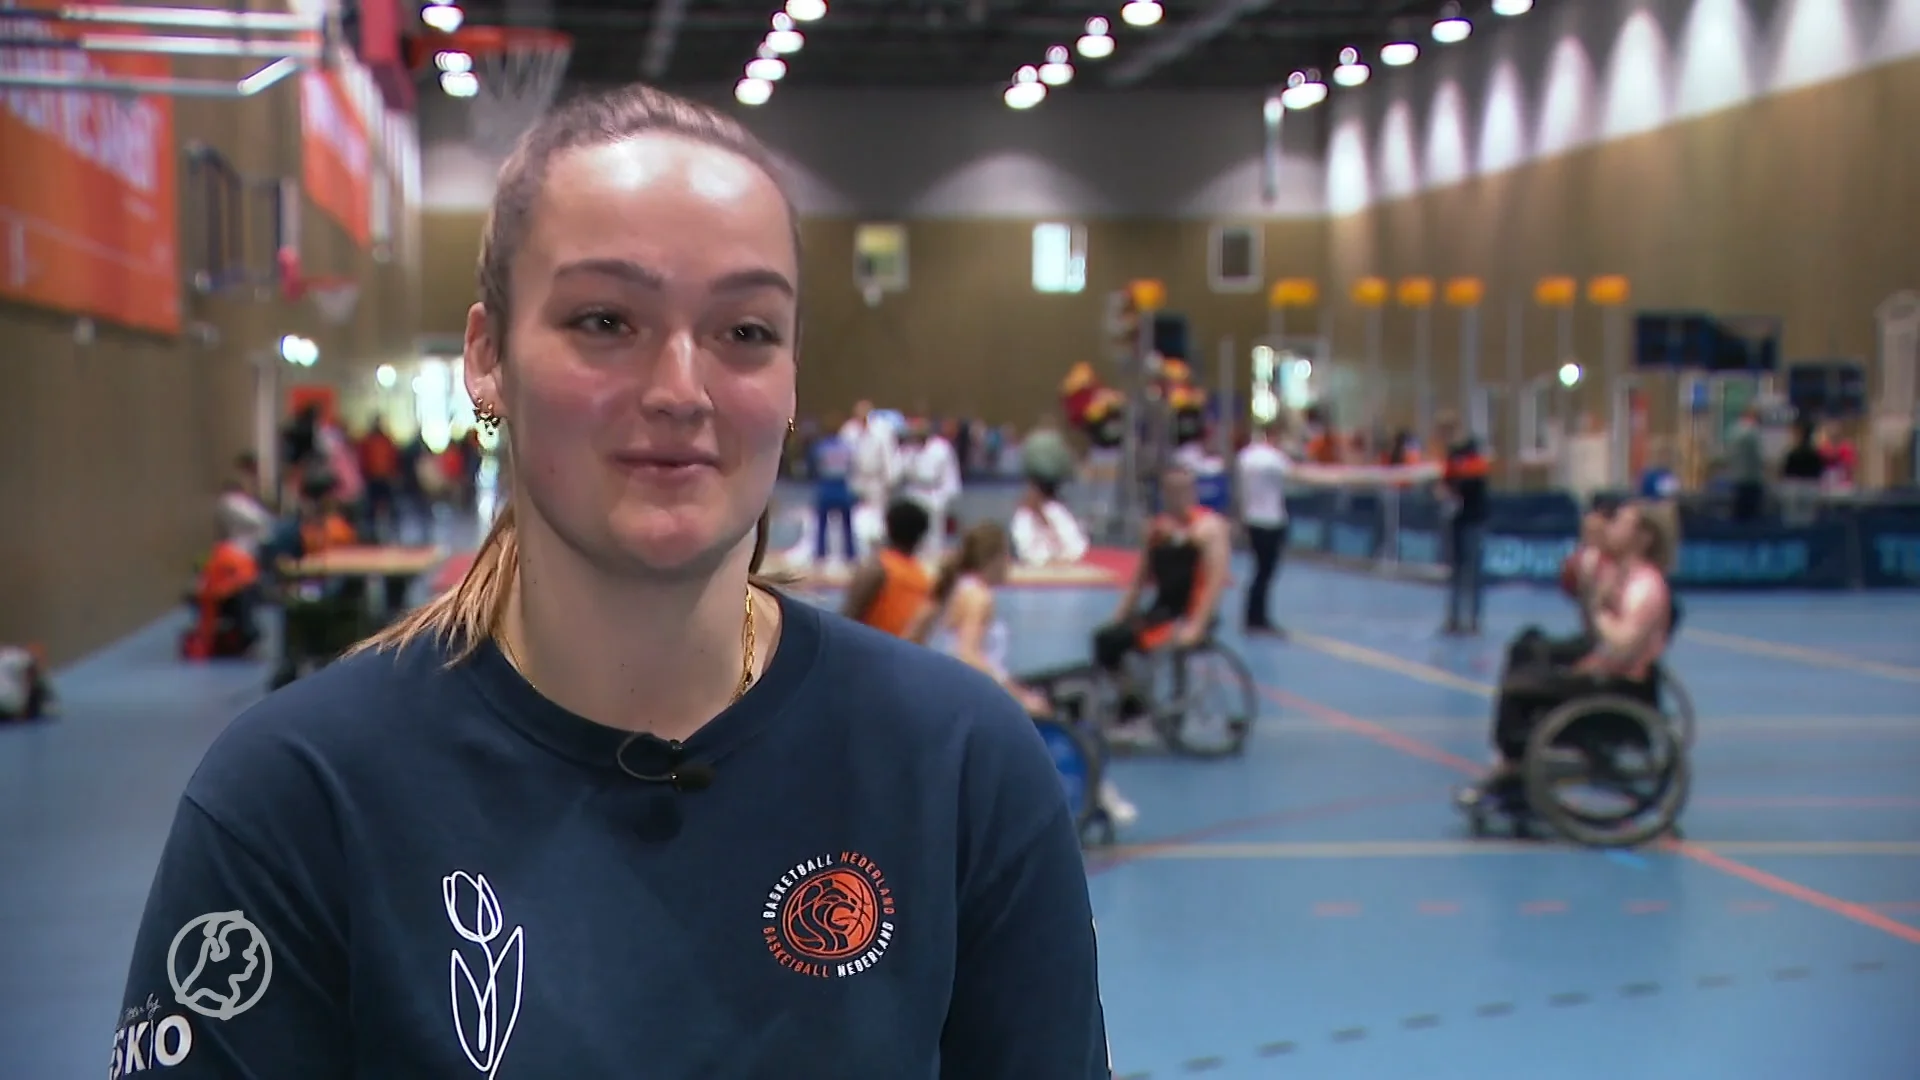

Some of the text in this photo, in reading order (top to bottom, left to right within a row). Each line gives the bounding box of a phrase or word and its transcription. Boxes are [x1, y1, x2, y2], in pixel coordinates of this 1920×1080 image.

[763, 852, 895, 919] BASKETBALL NEDERLAND
[764, 921, 893, 977] BASKETBALL NEDERLAND
